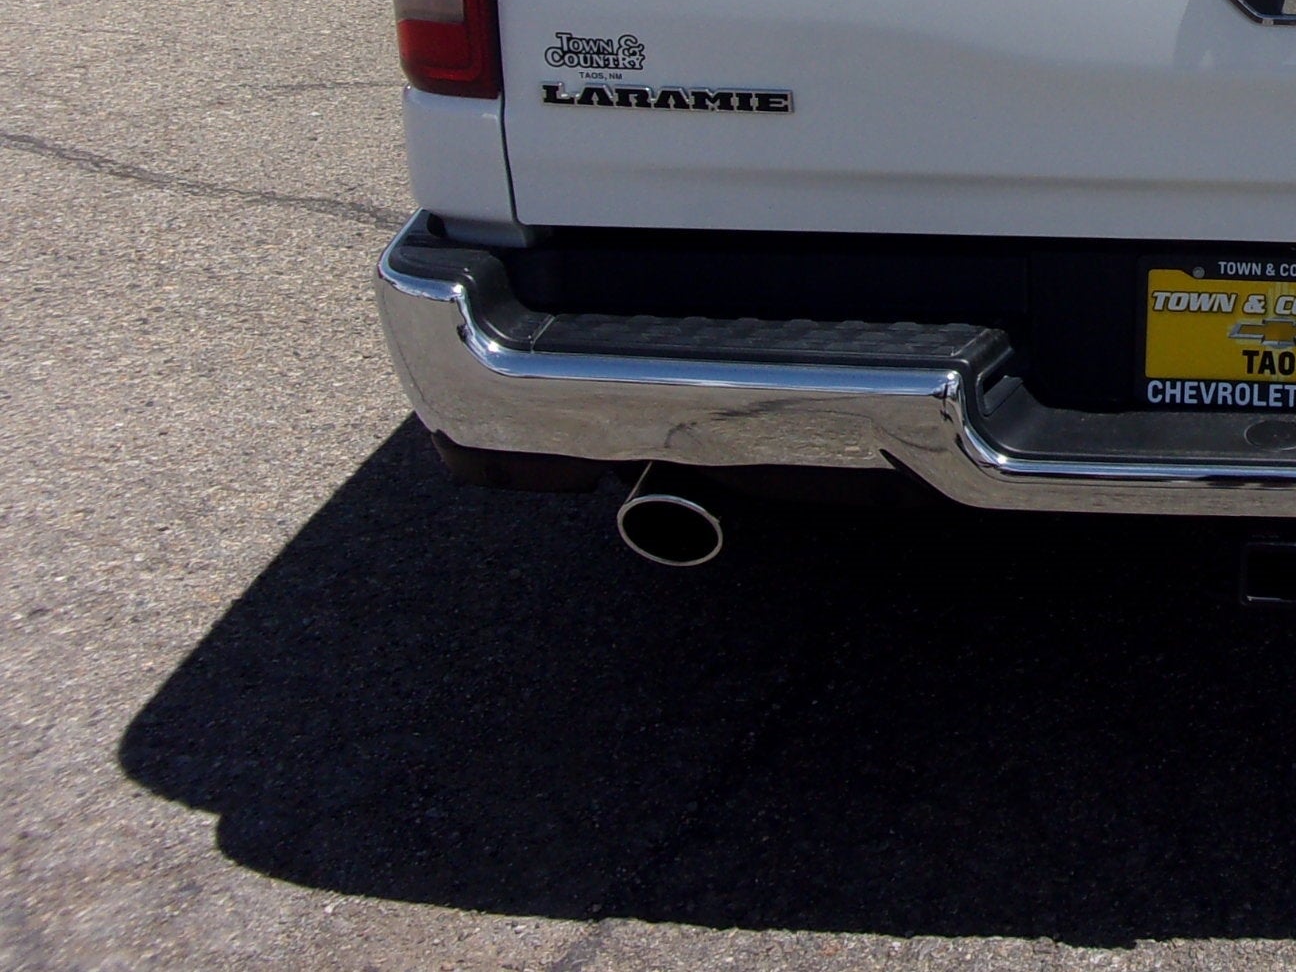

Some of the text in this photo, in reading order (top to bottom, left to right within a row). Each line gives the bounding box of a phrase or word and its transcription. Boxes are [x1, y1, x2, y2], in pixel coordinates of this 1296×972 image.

[555, 31, 645, 59] TOWN &
[544, 46, 645, 70] COUNTRY
[579, 71, 608, 80] TAOS,
[541, 82, 795, 114] LARAMIE
[1218, 261, 1262, 276] TOWN
[1265, 263, 1276, 276] &
[1152, 291, 1238, 314] TOWN
[1243, 293, 1267, 314] &
